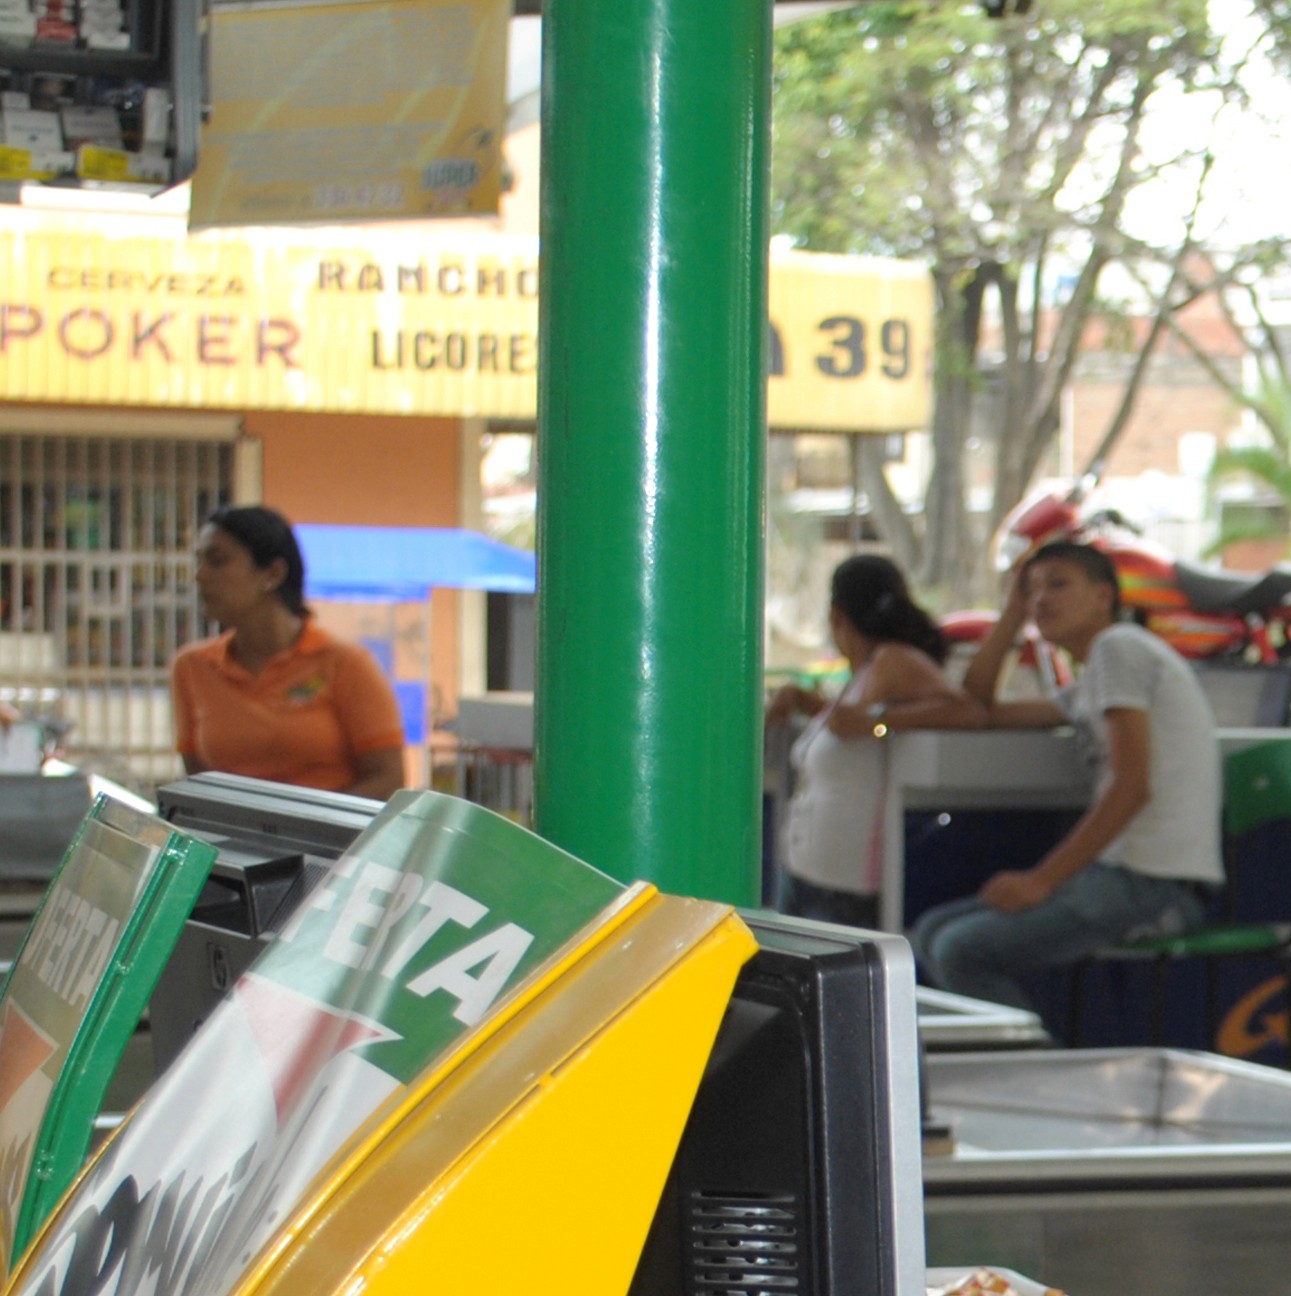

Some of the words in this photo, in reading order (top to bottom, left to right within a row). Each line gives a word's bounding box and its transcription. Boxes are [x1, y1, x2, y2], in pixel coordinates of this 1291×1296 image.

[47, 266, 246, 295] CERVEZA
[0, 303, 301, 367] POKER
[371, 328, 538, 374] LICORE
